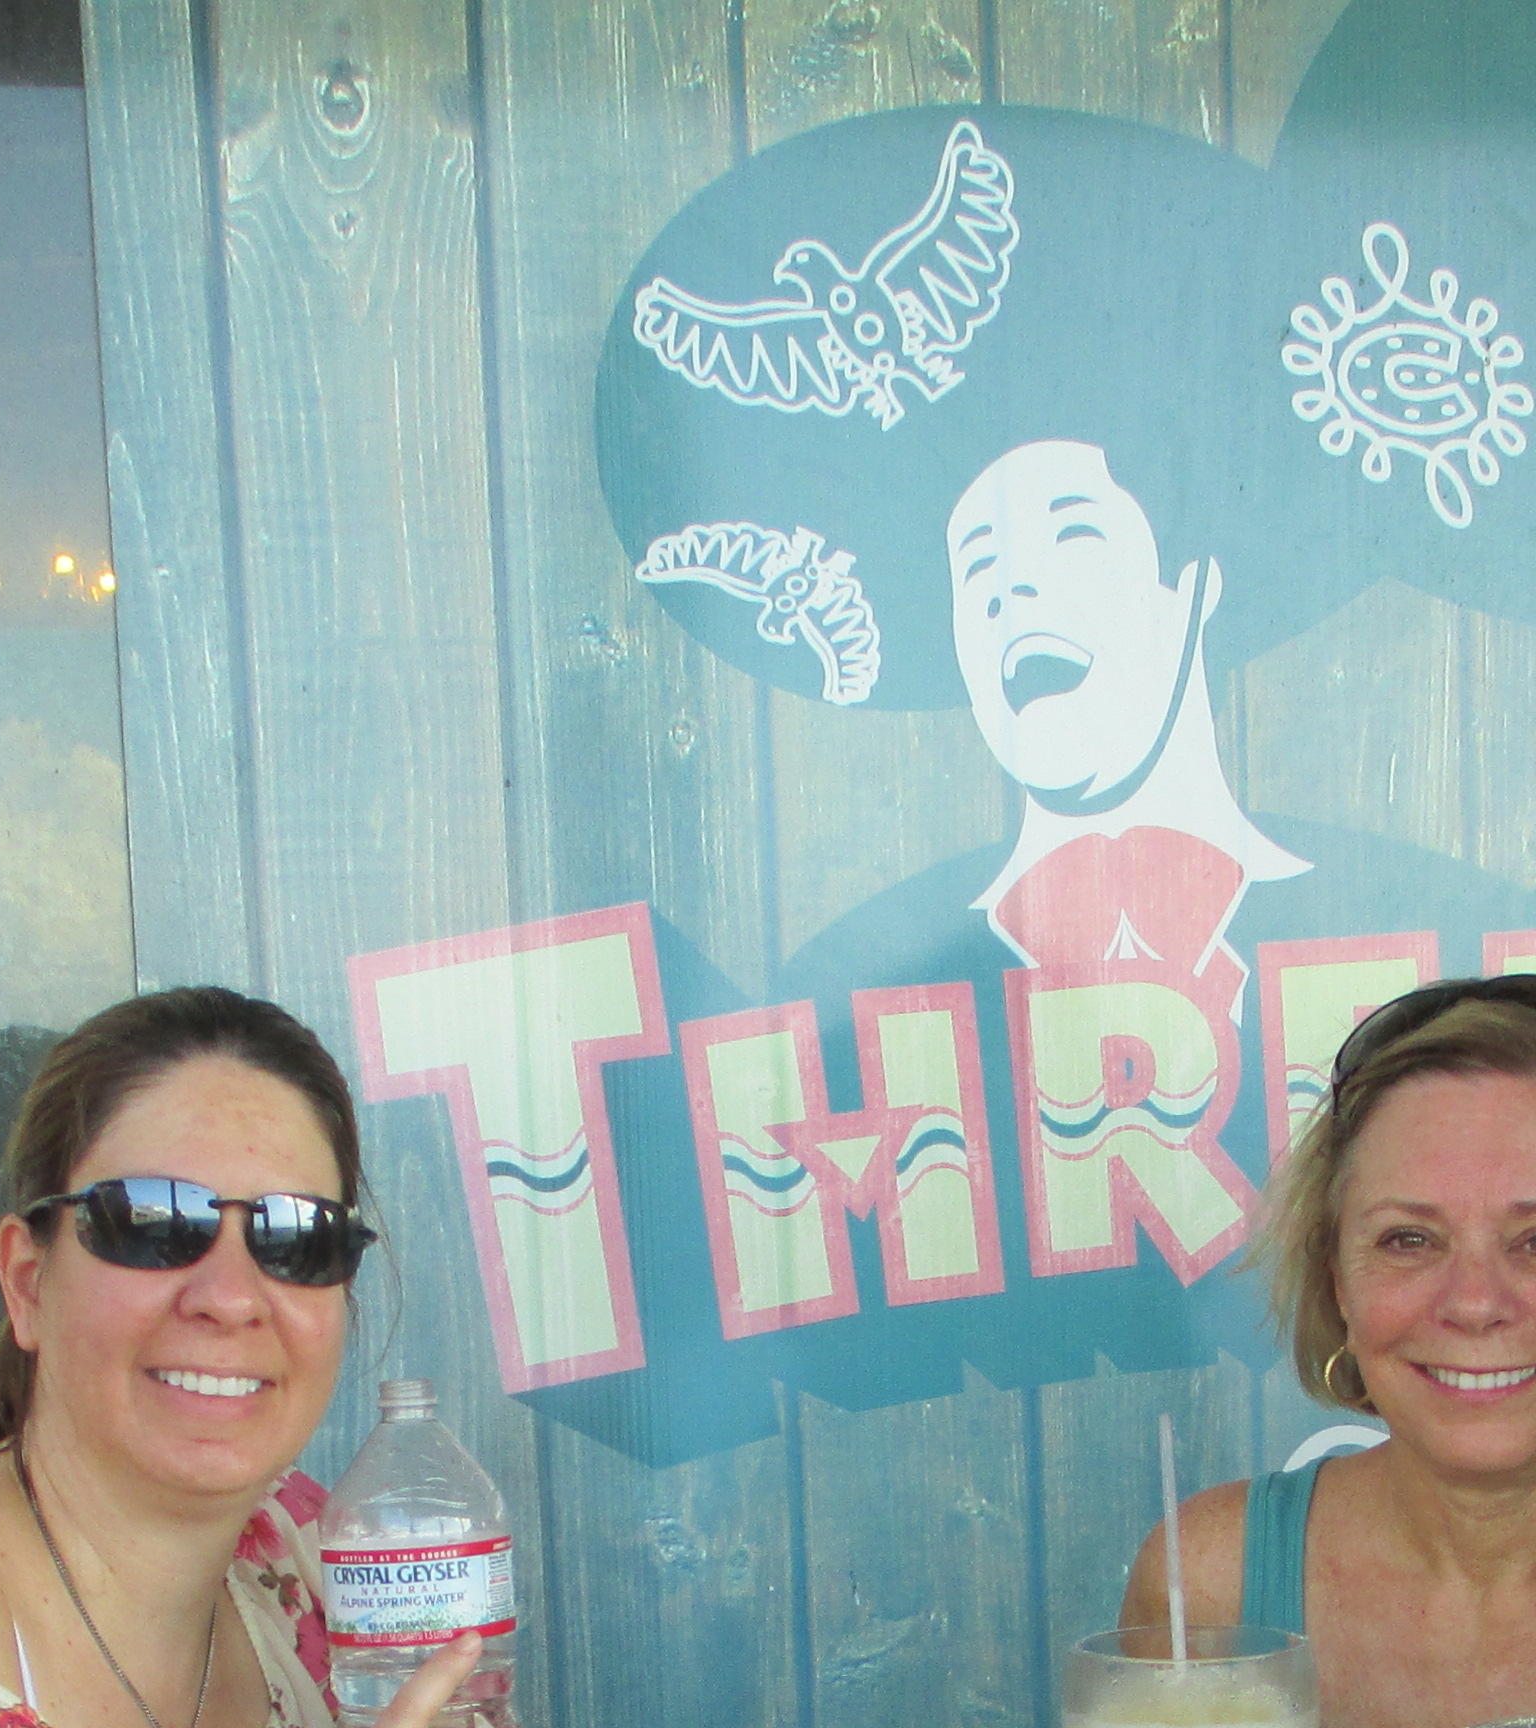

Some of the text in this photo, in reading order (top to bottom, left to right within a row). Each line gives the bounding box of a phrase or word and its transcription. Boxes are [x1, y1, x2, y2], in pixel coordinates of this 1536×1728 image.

[333, 1561, 470, 1585] CRYSTAL GEYSER
[360, 1584, 440, 1596] NATURAL
[340, 1592, 465, 1609] ALPINE SPRING WATER
